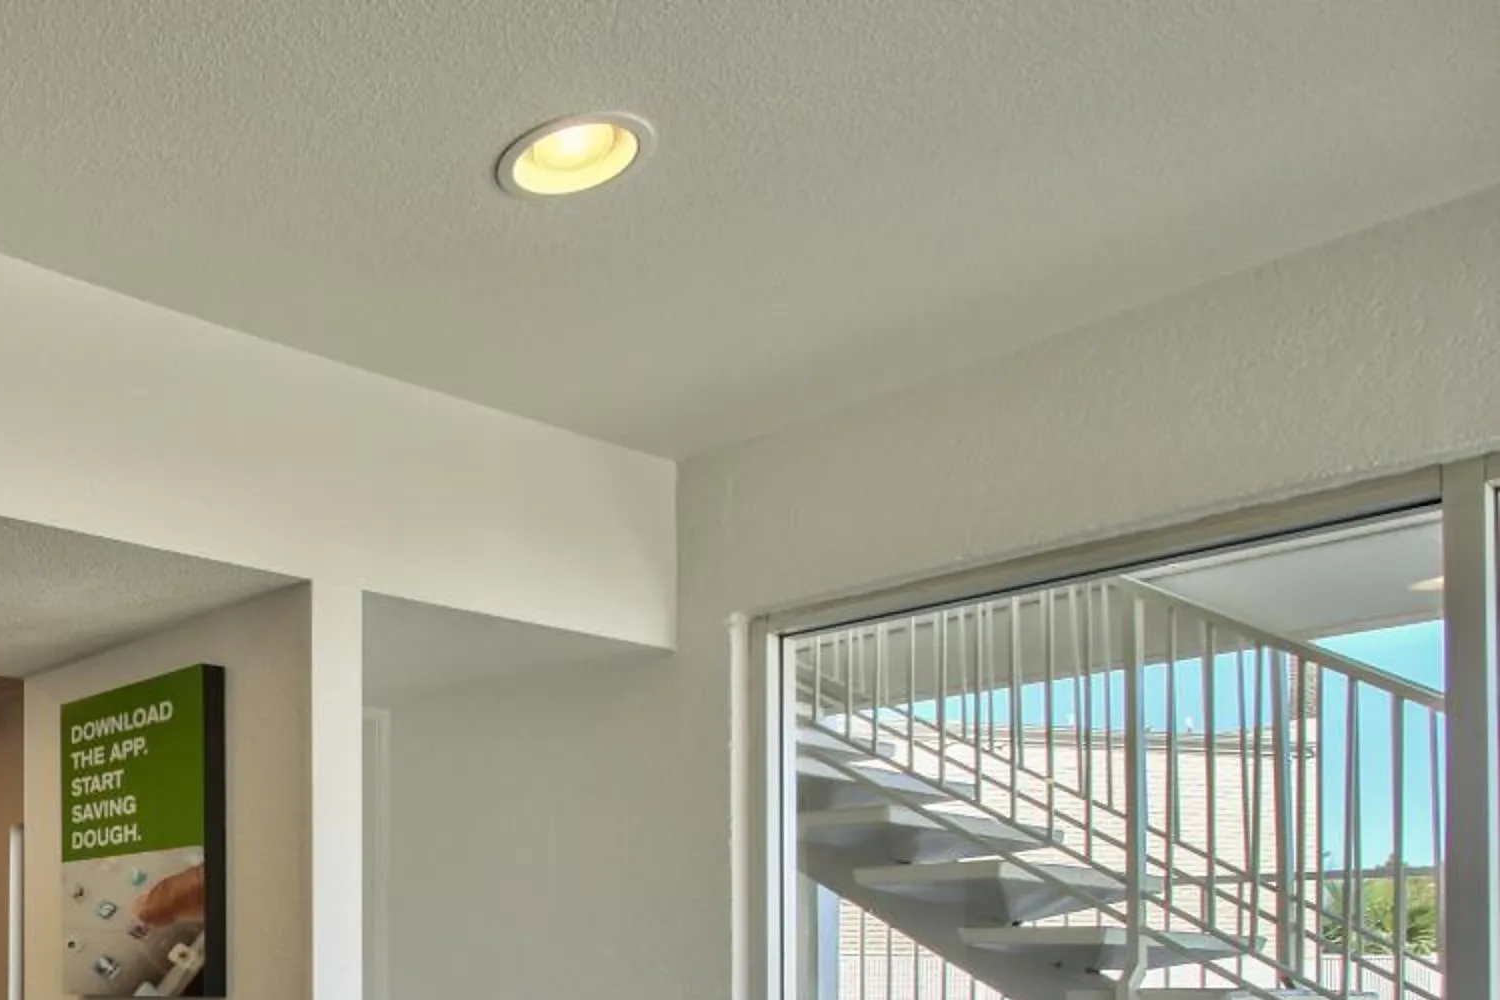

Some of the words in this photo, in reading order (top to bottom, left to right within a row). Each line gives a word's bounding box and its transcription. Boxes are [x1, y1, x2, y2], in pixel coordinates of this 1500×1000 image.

[71, 700, 174, 744] DOWNLOAD
[70, 746, 105, 770] THE
[109, 736, 149, 764] APP.
[71, 769, 125, 797] START
[71, 795, 138, 824] SAVING
[71, 824, 143, 849] DOUGH.
